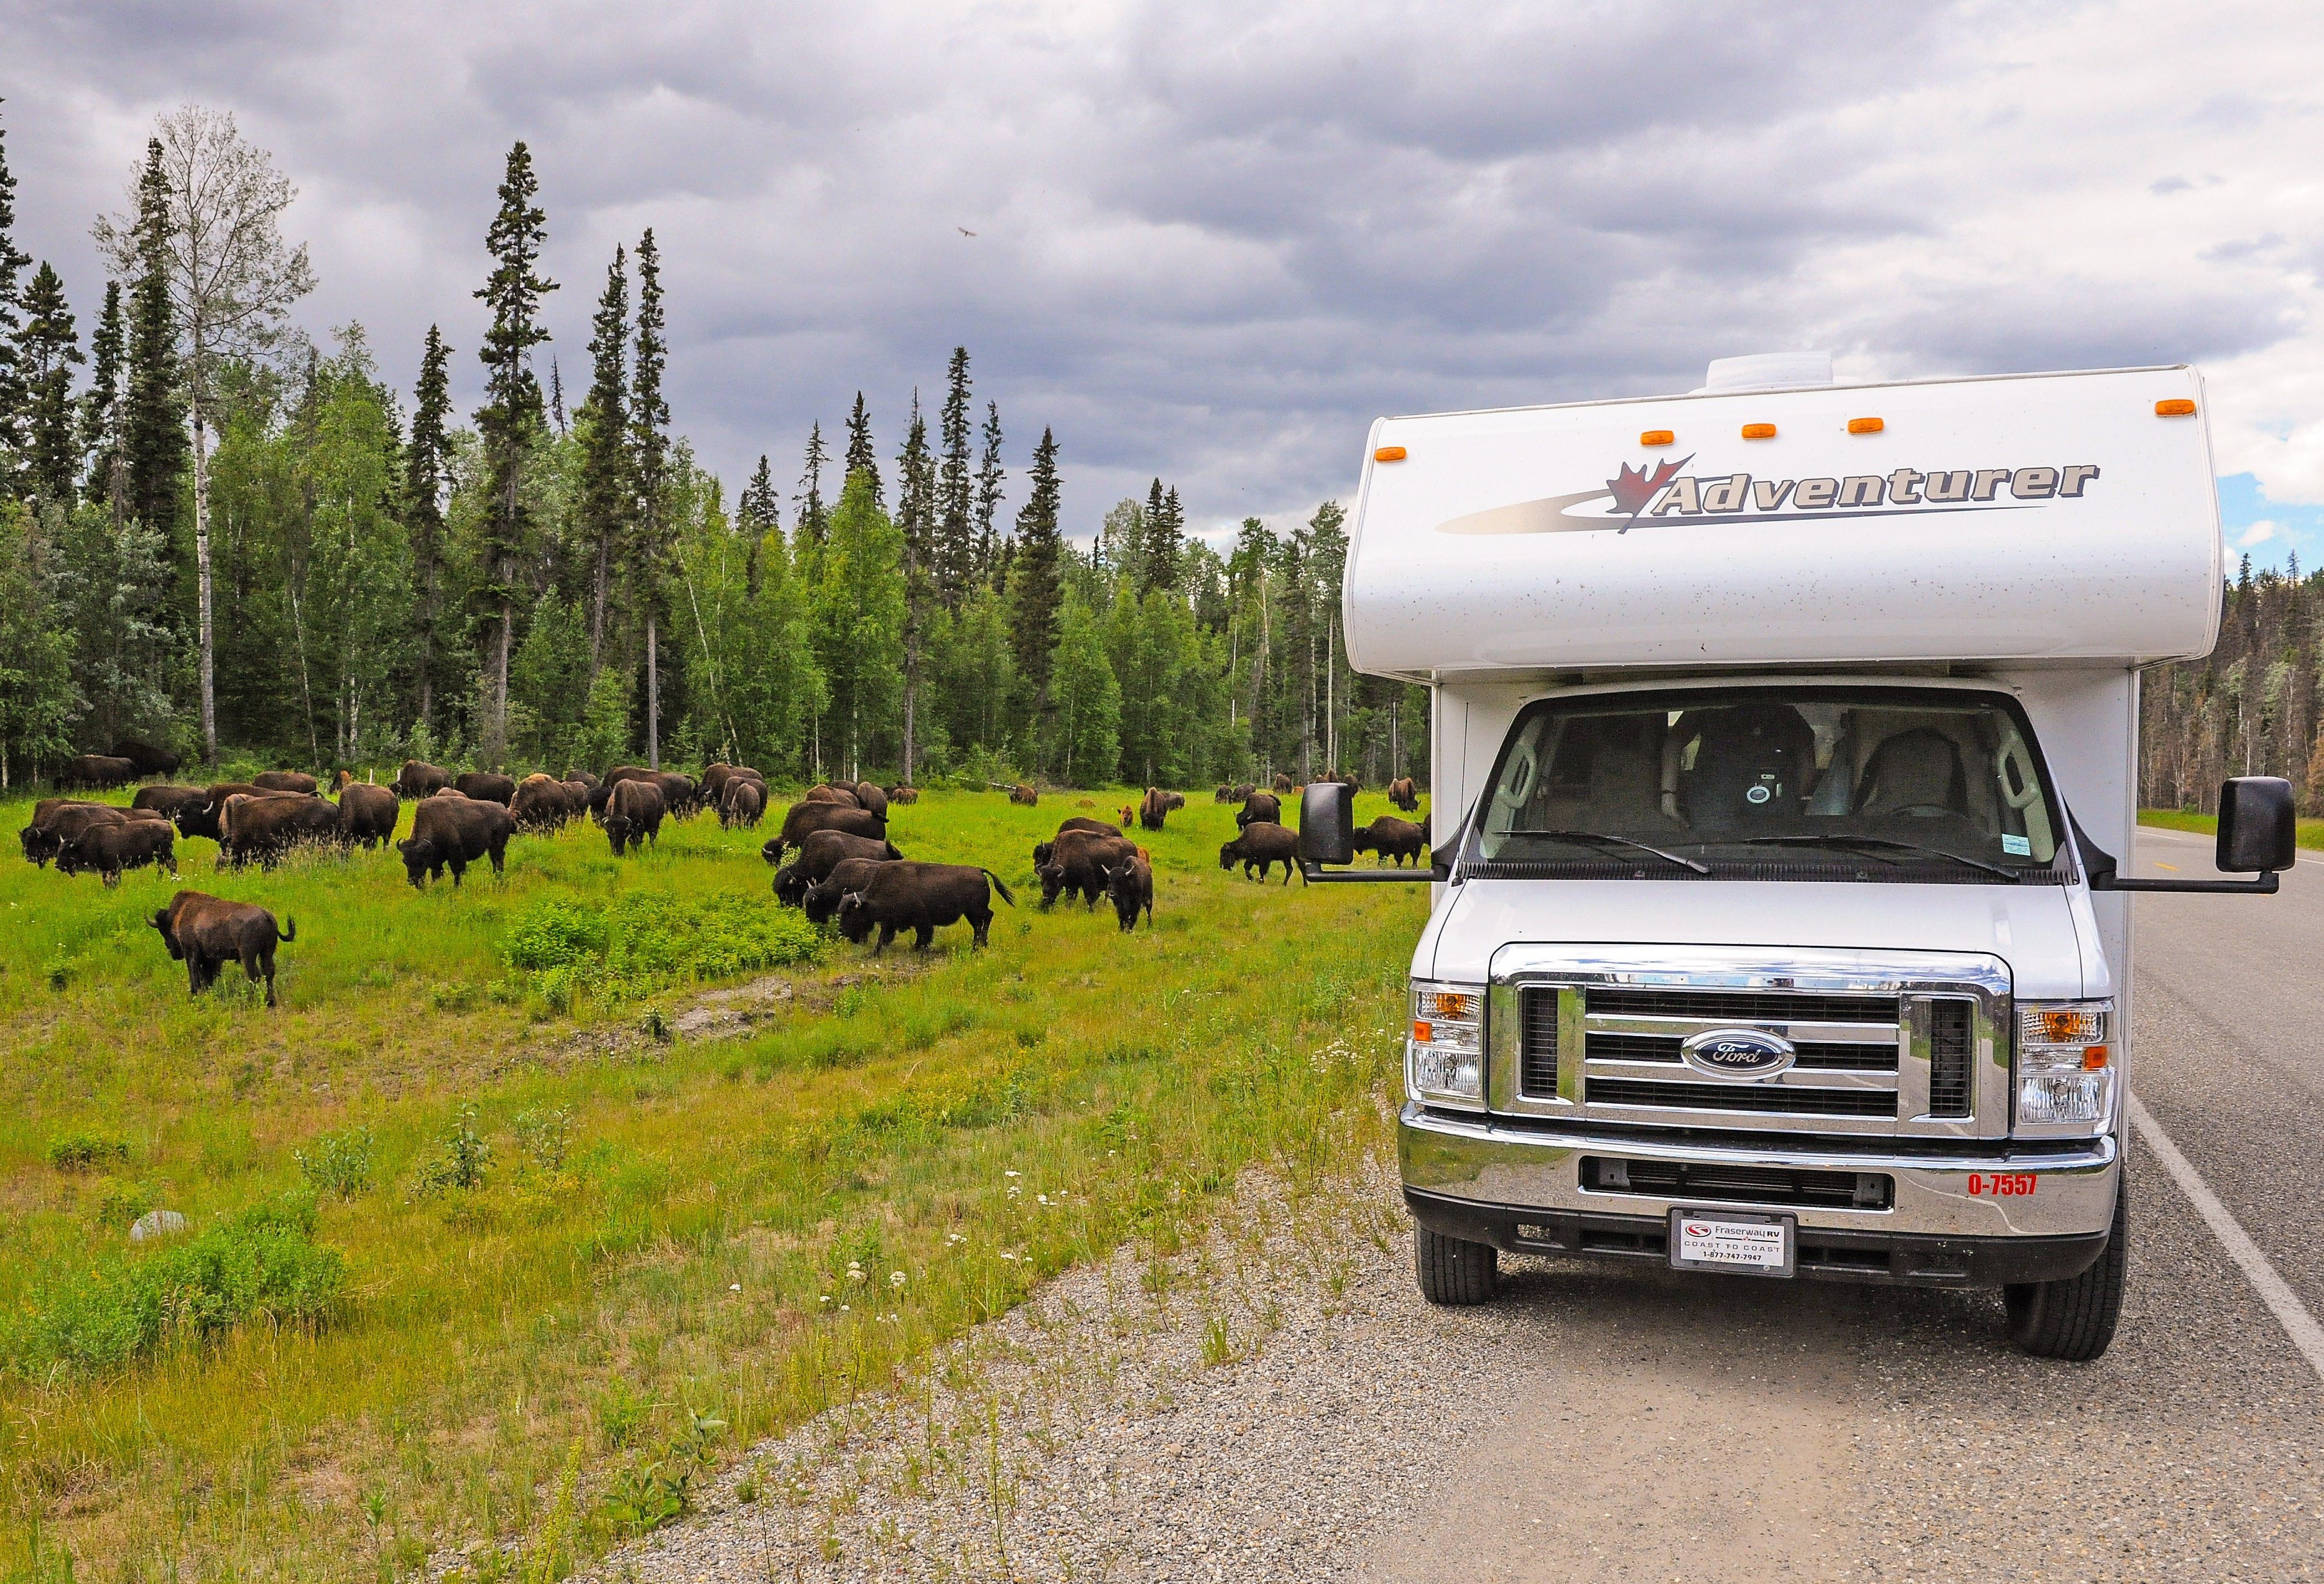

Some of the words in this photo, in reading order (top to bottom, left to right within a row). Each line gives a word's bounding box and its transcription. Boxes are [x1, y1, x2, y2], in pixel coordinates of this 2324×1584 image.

[1650, 465, 2100, 516] Adventurer
[1713, 1042, 1761, 1063] Ford
[1715, 1226, 1765, 1238] Fraserway
[1684, 1241, 1720, 1249] COAST
[1743, 1244, 1780, 1253] COAST
[1703, 1251, 1761, 1261] 1-877-747-7947
